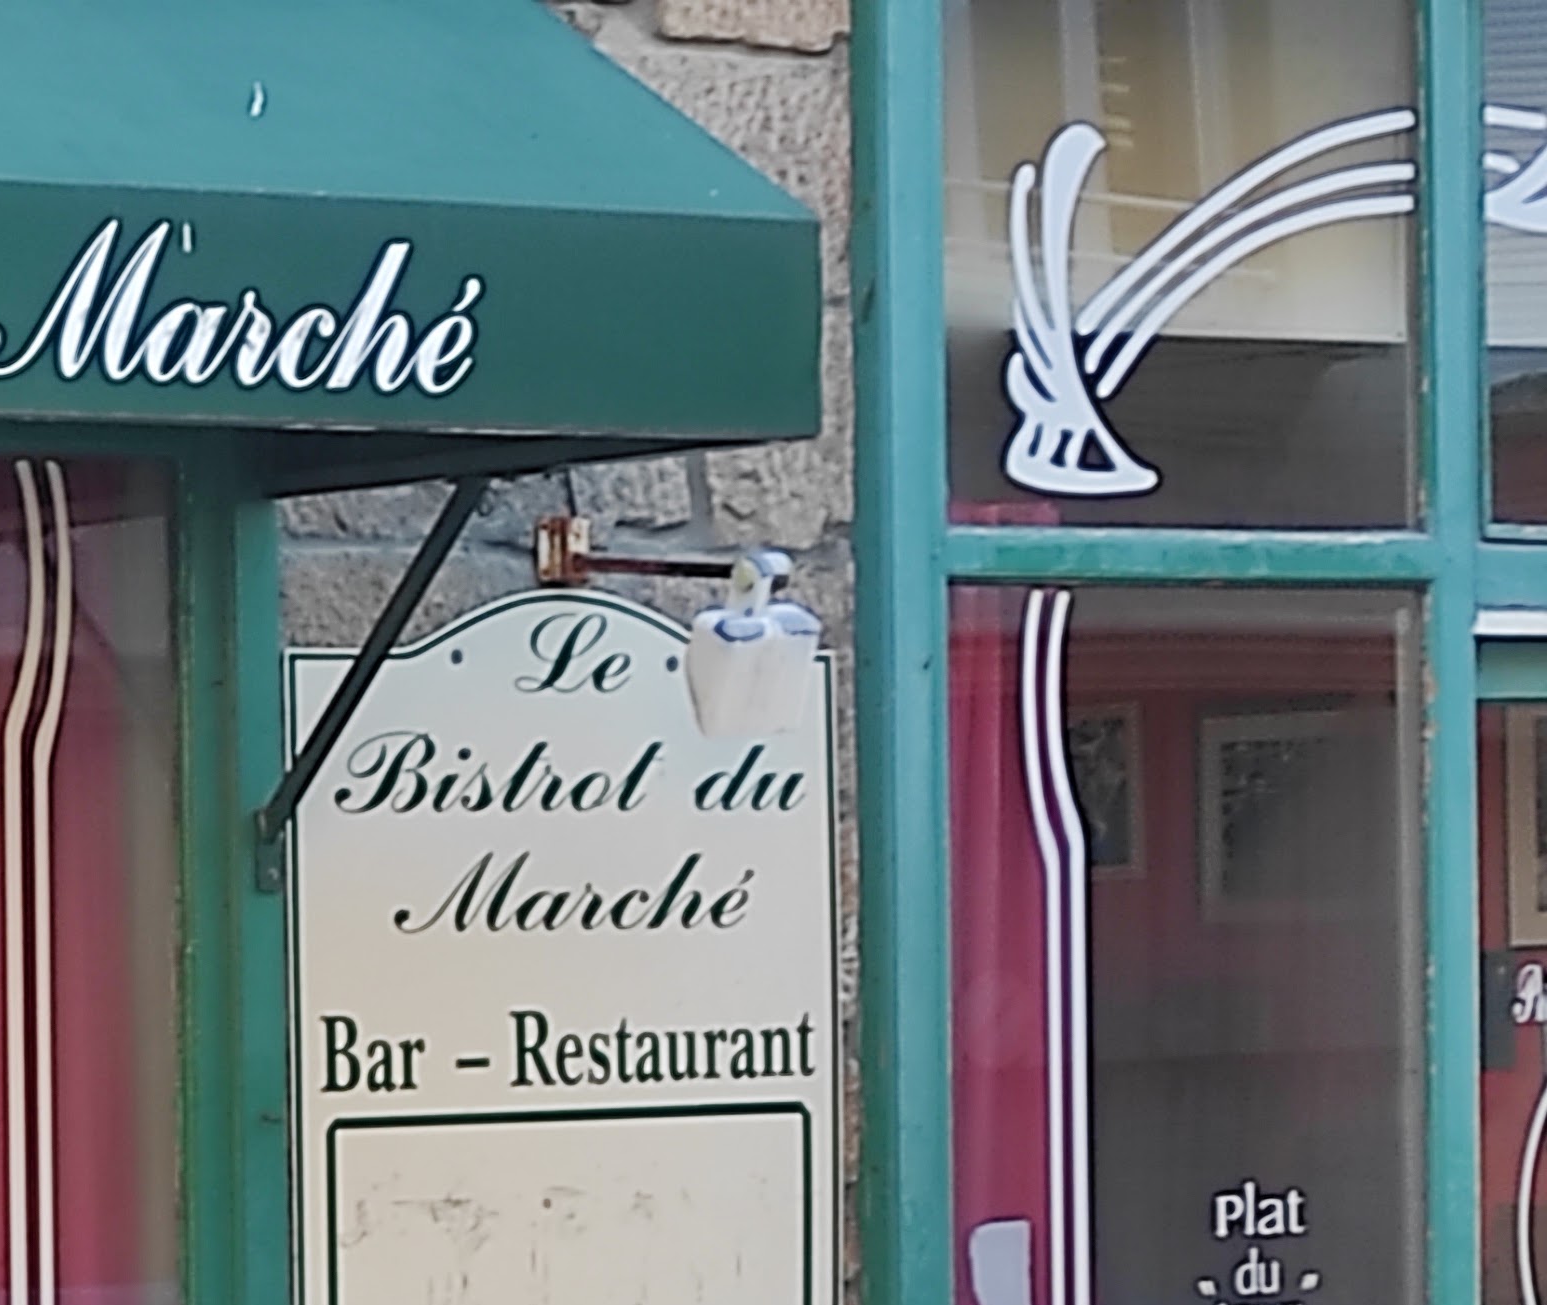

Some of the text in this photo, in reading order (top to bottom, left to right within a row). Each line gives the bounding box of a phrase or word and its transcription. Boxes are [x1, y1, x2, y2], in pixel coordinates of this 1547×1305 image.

[514, 613, 631, 693] Le
[334, 731, 805, 813] Bistrot du
[394, 852, 754, 933] Marché
[320, 1015, 425, 1092] Bar
[510, 1011, 815, 1086] Restaurant
[1215, 1181, 1308, 1237] Plat
[1235, 1247, 1280, 1295] du
